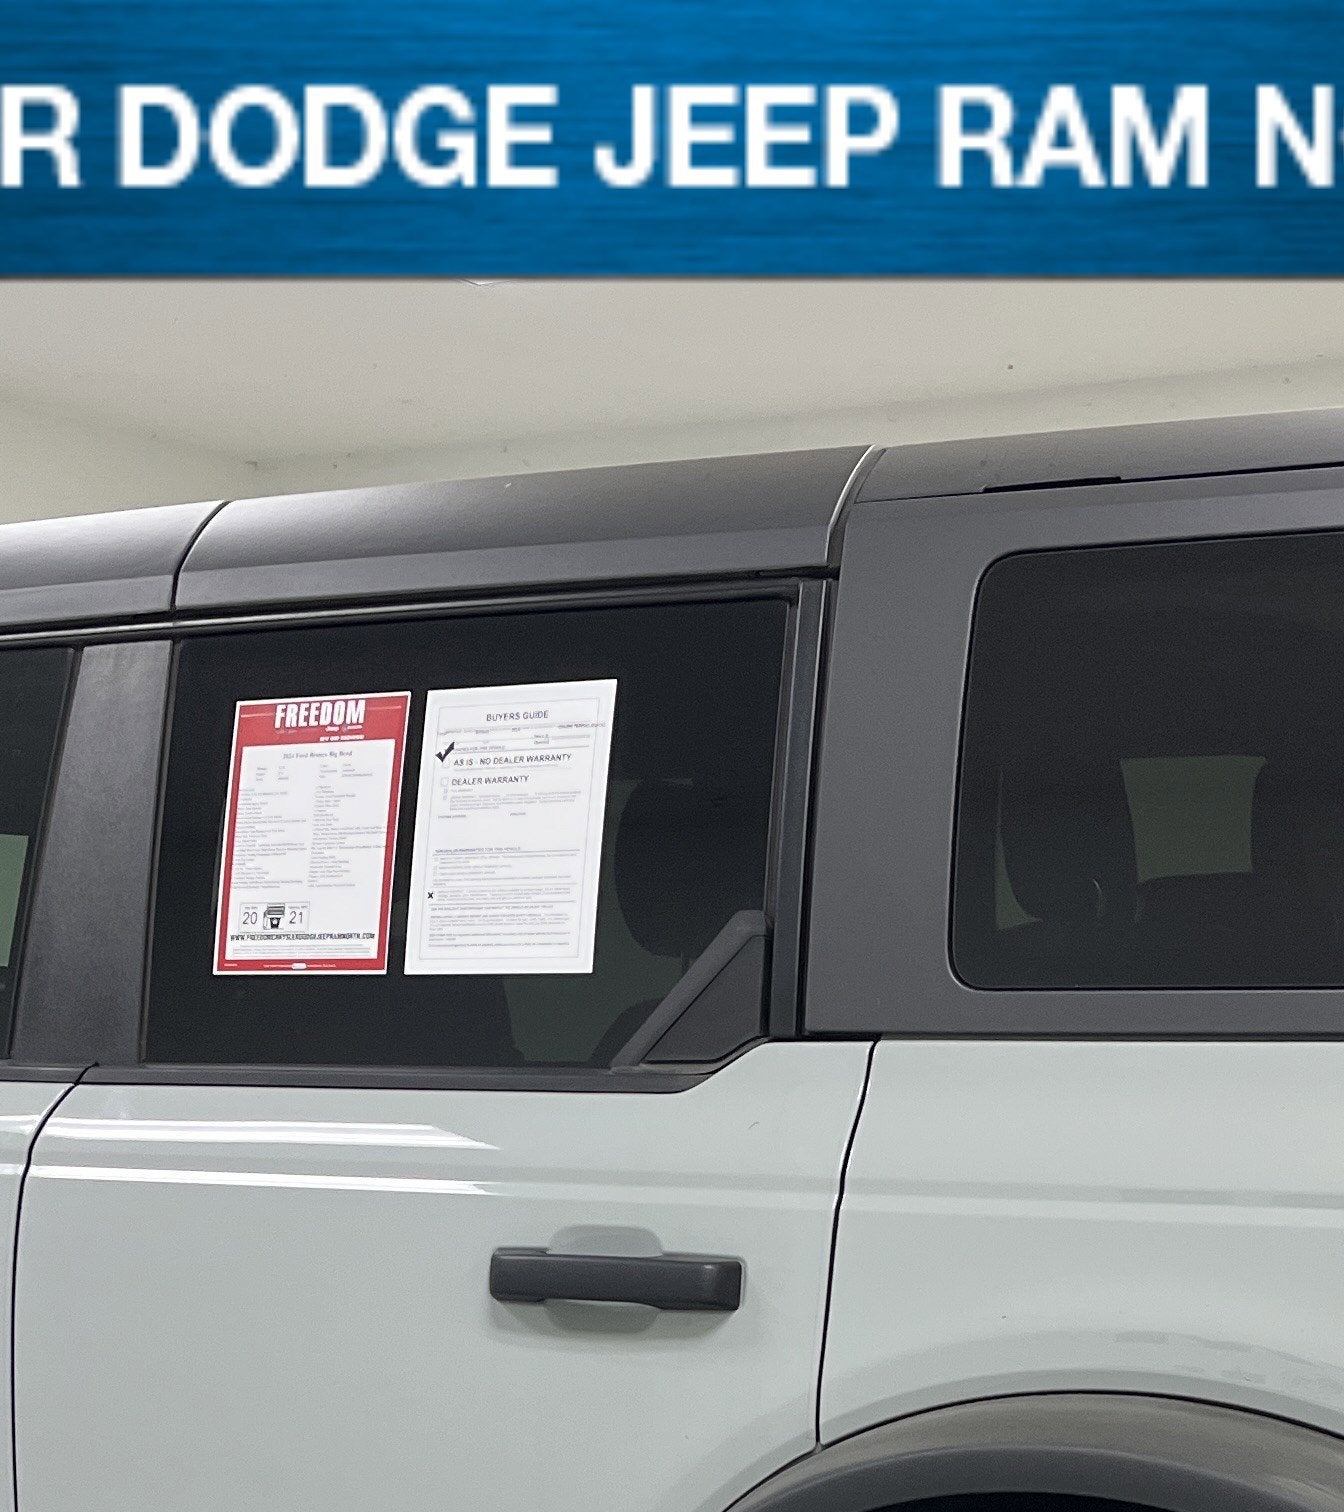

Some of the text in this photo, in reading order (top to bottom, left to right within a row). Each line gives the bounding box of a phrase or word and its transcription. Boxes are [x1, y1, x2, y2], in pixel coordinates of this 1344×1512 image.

[274, 700, 366, 729] FREEDOM
[486, 709, 550, 722] BUYERS GUIDE
[453, 753, 572, 767] AS IS NO DEALER WARRANTY
[451, 775, 530, 786] DEALER WARRANTY
[242, 910, 303, 925] 20 21
